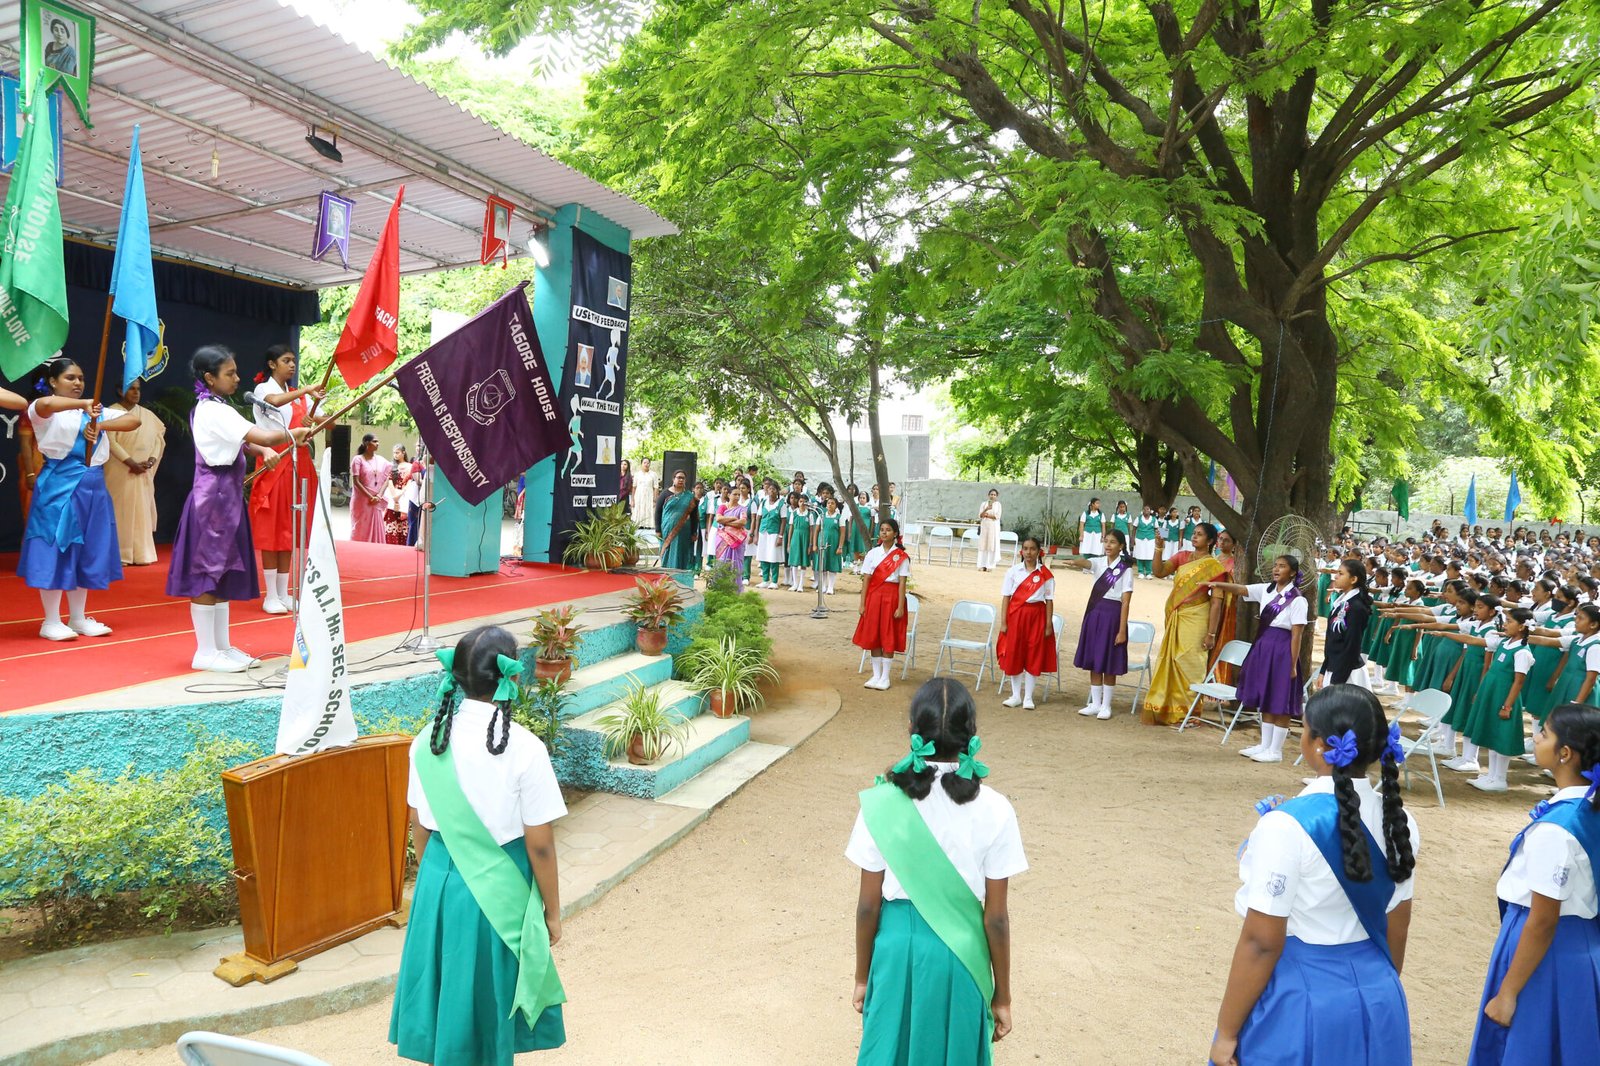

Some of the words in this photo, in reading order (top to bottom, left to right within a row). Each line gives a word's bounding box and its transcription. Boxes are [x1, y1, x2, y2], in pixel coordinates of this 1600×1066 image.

[5, 315, 31, 347] LOVE
[575, 308, 590, 320] USE
[600, 317, 626, 329] FEEDBACK
[415, 361, 442, 407] FREEDOM
[509, 312, 538, 371] TAGORE
[531, 376, 556, 421] HOUSE
[434, 403, 448, 416] IS
[607, 404, 619, 413] TALK
[439, 413, 490, 488] RESPONSIBILITY
[312, 584, 336, 613] A.I.
[332, 643, 345, 684] SEC.
